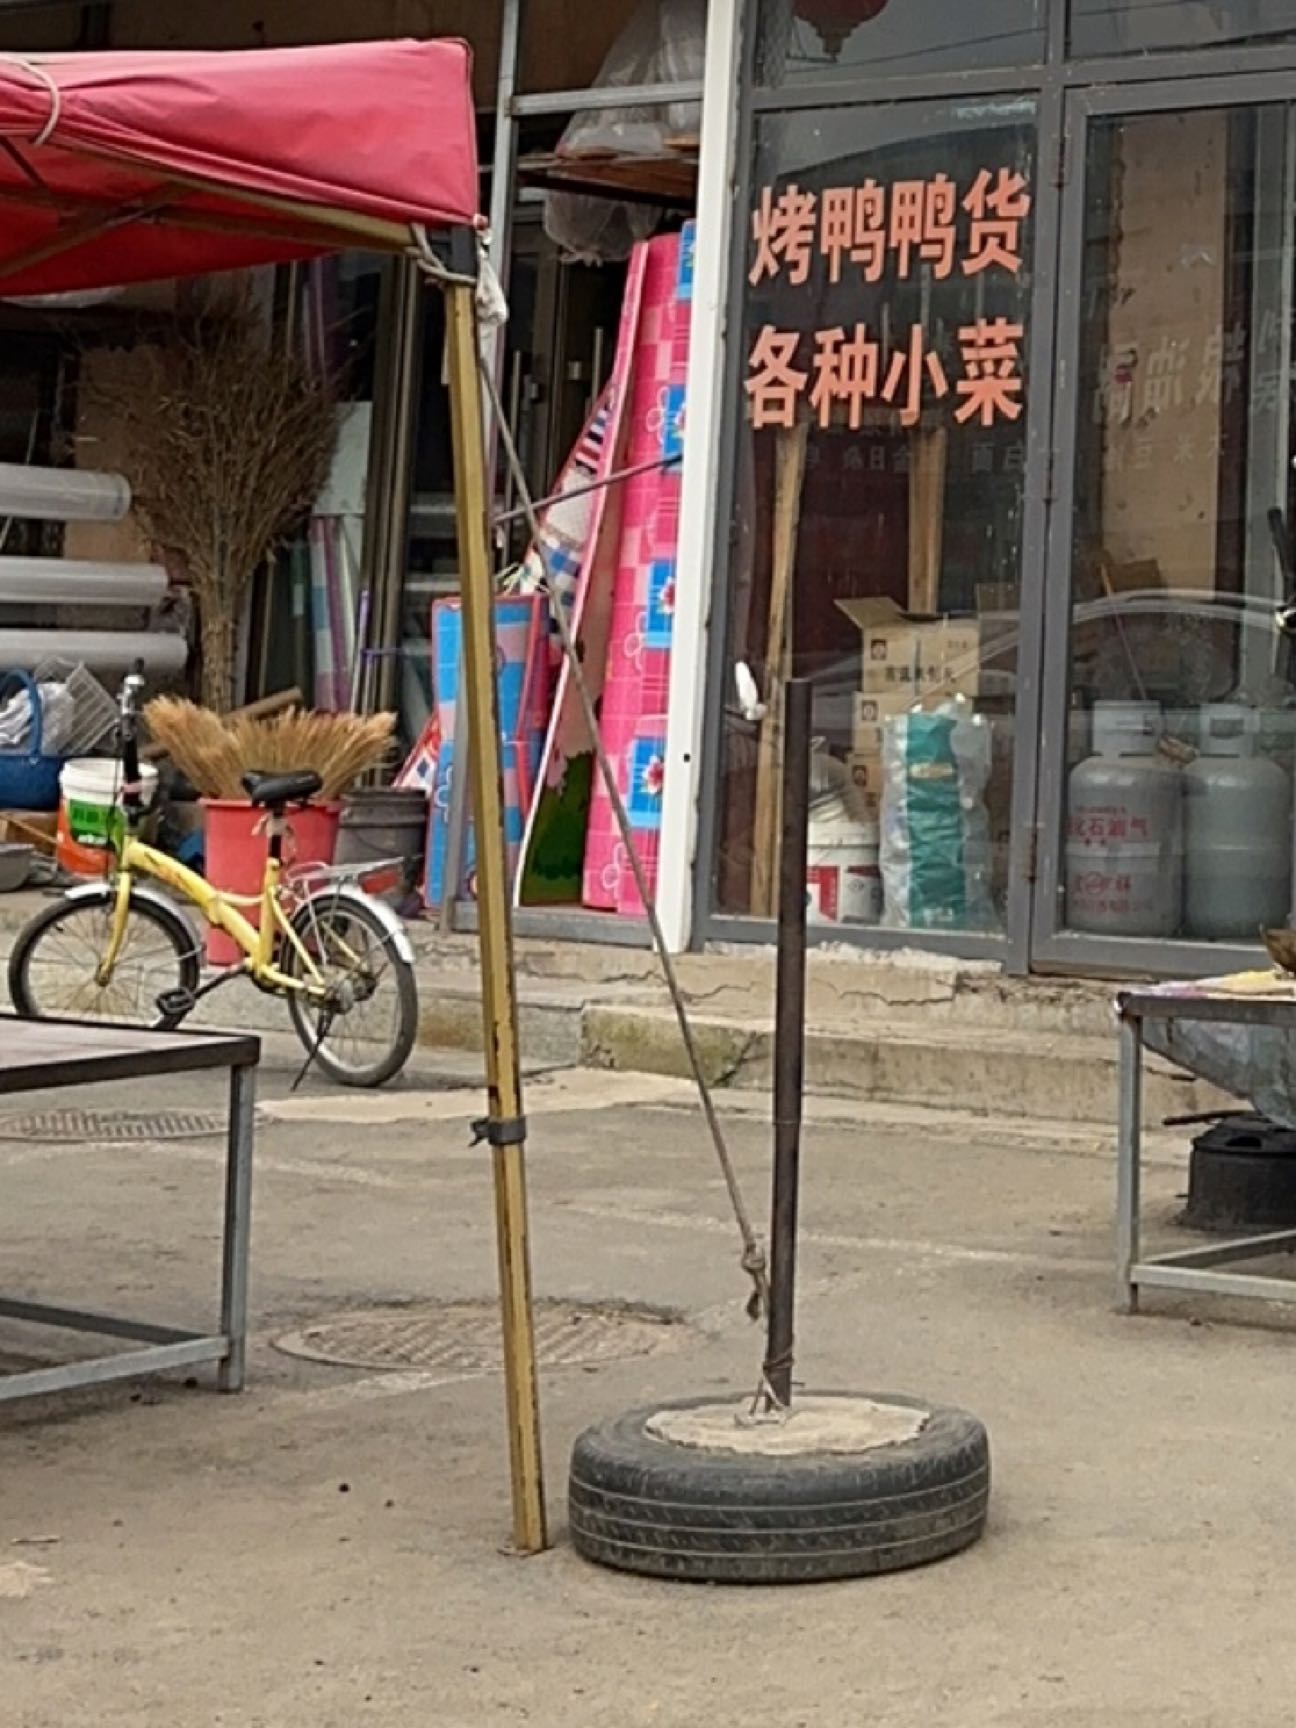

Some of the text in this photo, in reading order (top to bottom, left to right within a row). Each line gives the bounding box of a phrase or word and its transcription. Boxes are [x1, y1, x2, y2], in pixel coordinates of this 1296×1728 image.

[748, 167, 1033, 287] 烤鸭鸭货
[744, 316, 1026, 431] 各种小菜
